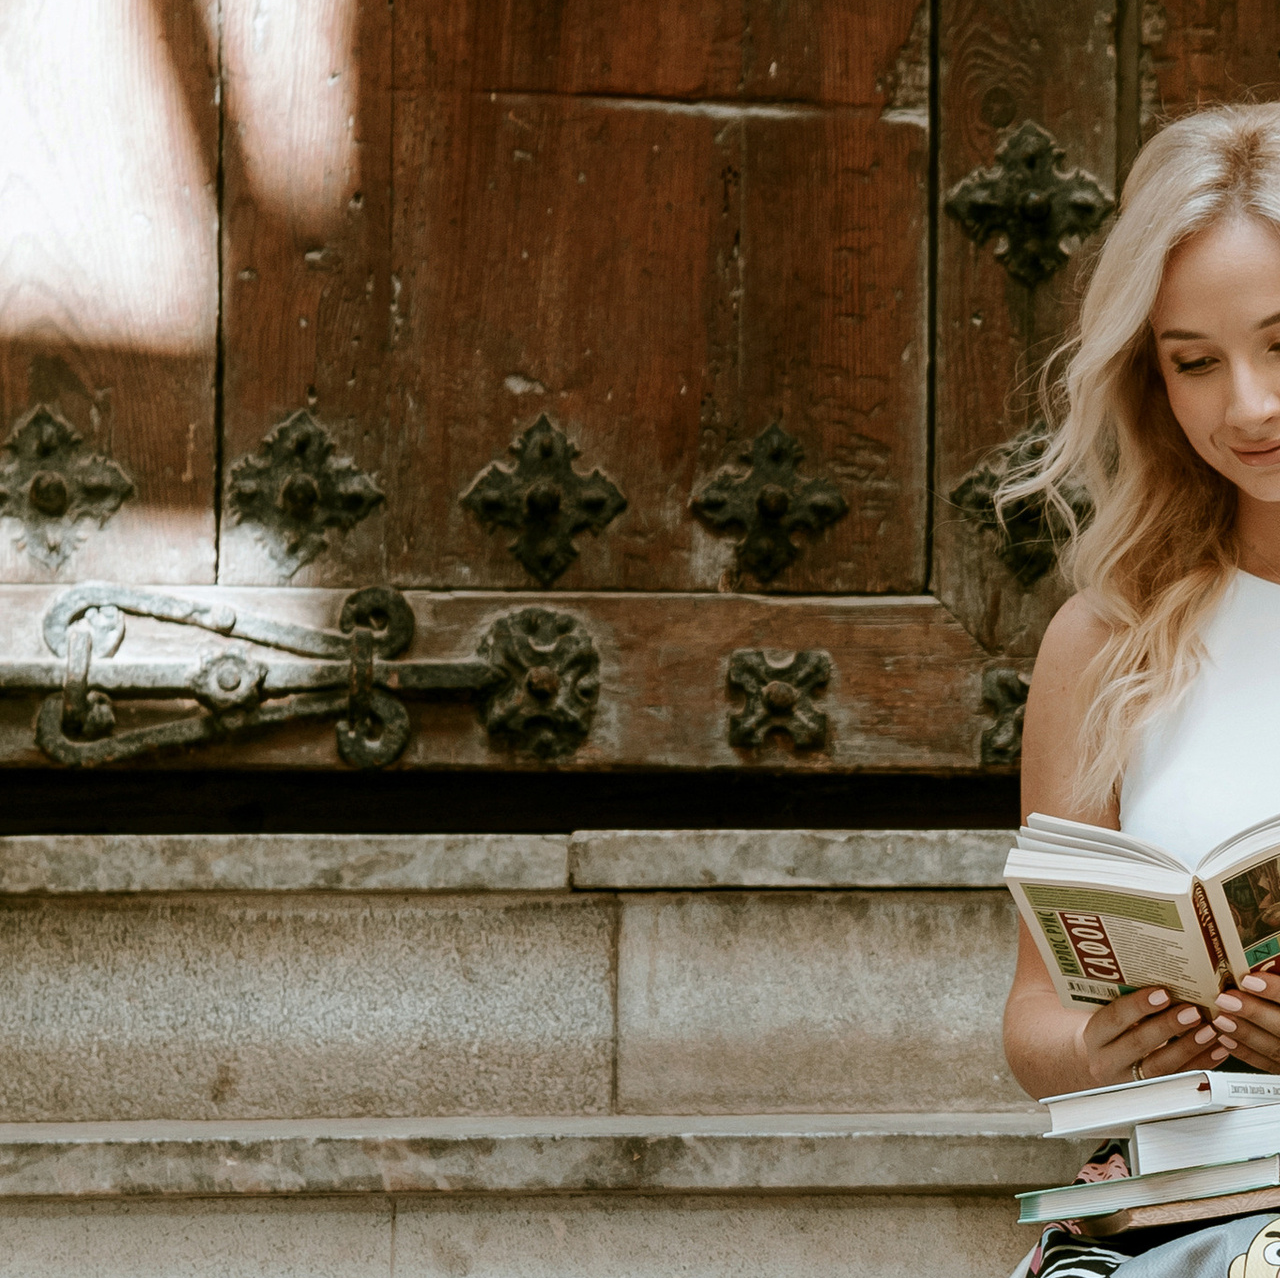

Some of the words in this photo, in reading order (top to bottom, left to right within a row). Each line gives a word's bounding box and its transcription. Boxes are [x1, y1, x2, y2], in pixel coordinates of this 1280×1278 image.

[1037, 911, 1063, 935] РУИС
[1050, 938, 1079, 975] КАРЛОС
[1064, 913, 1120, 980] САФОН
